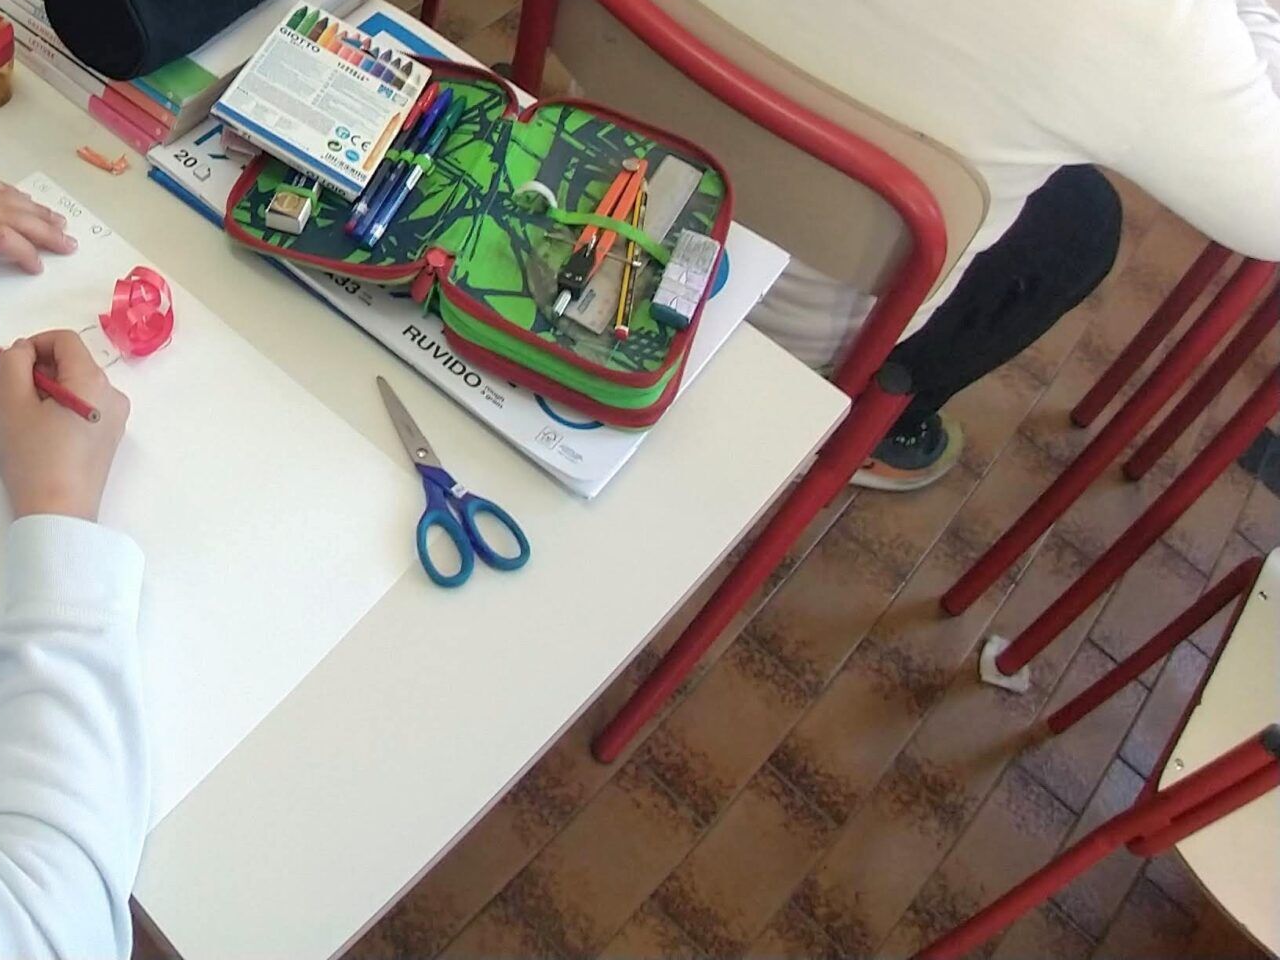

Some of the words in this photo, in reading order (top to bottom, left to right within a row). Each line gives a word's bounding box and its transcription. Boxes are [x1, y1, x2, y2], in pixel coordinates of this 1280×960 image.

[279, 26, 321, 54] GIOTTO
[173, 148, 198, 169] 20
[401, 324, 482, 389] RUVIDO
